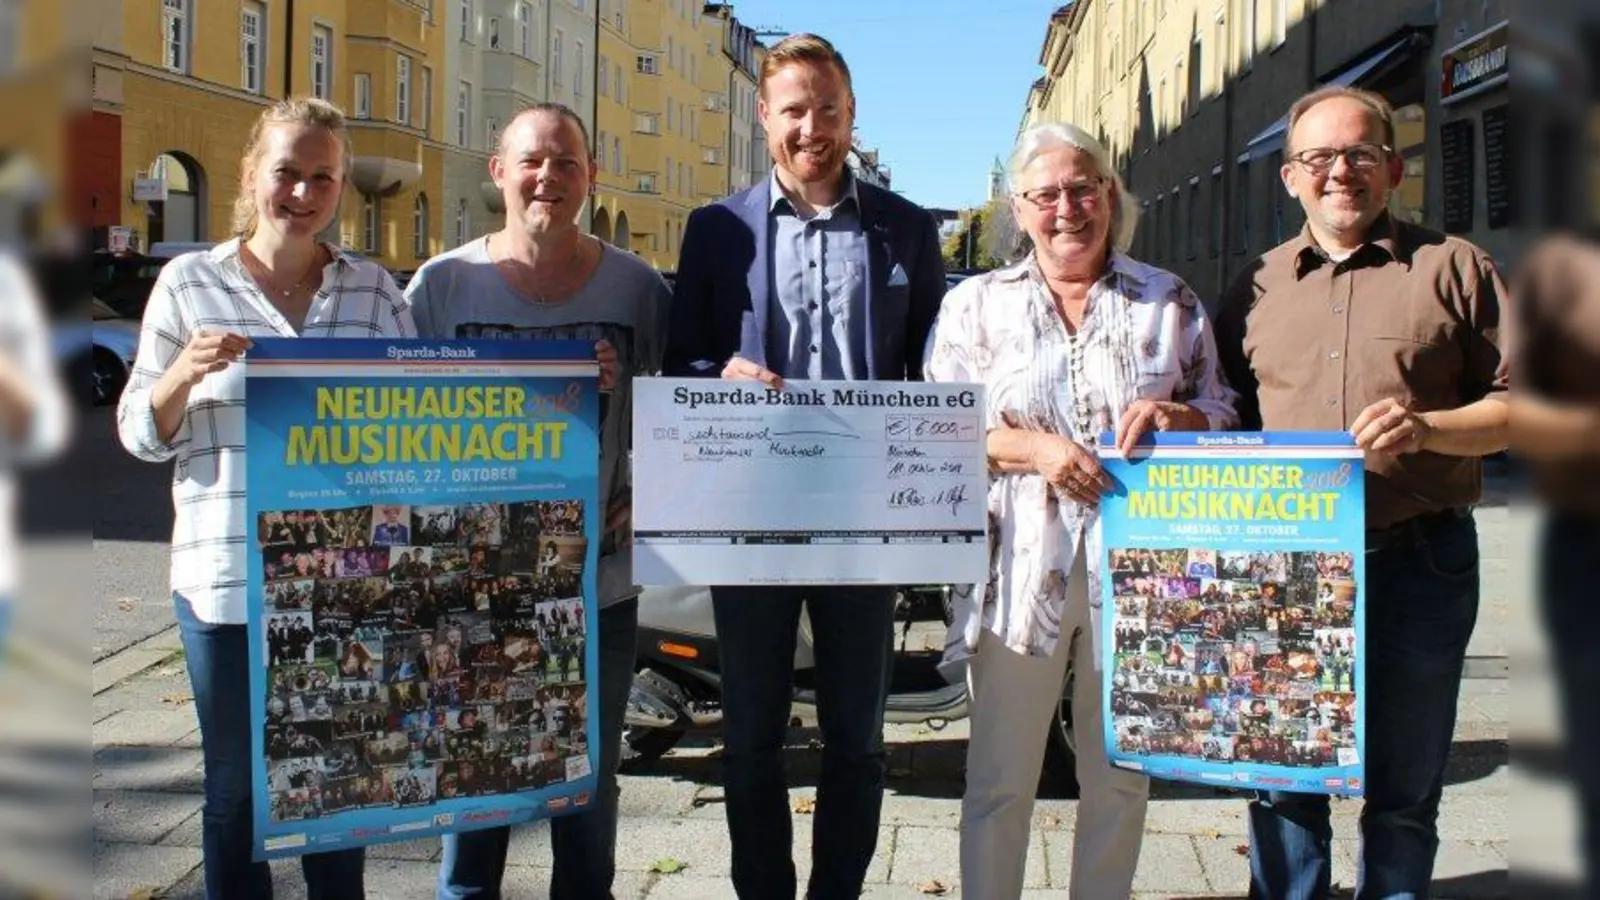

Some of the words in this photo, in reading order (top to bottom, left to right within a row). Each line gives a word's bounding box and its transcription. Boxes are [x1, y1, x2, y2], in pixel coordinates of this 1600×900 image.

[387, 345, 476, 360] Sparda-Bank
[316, 385, 526, 420] NEUHAUSER
[673, 386, 826, 409] Sparda-Bank
[832, 386, 940, 408] München
[946, 390, 976, 408] eG
[285, 421, 568, 466] MUSIKNACHT
[1197, 436, 1264, 448] Sparda-Bank
[423, 468, 446, 483] 27.
[451, 466, 517, 482] OKTOBER
[1148, 463, 1303, 489] NEUHAUSER
[1126, 490, 1341, 522] MUSIKNACHT
[1246, 525, 1299, 536] OKTOBER
